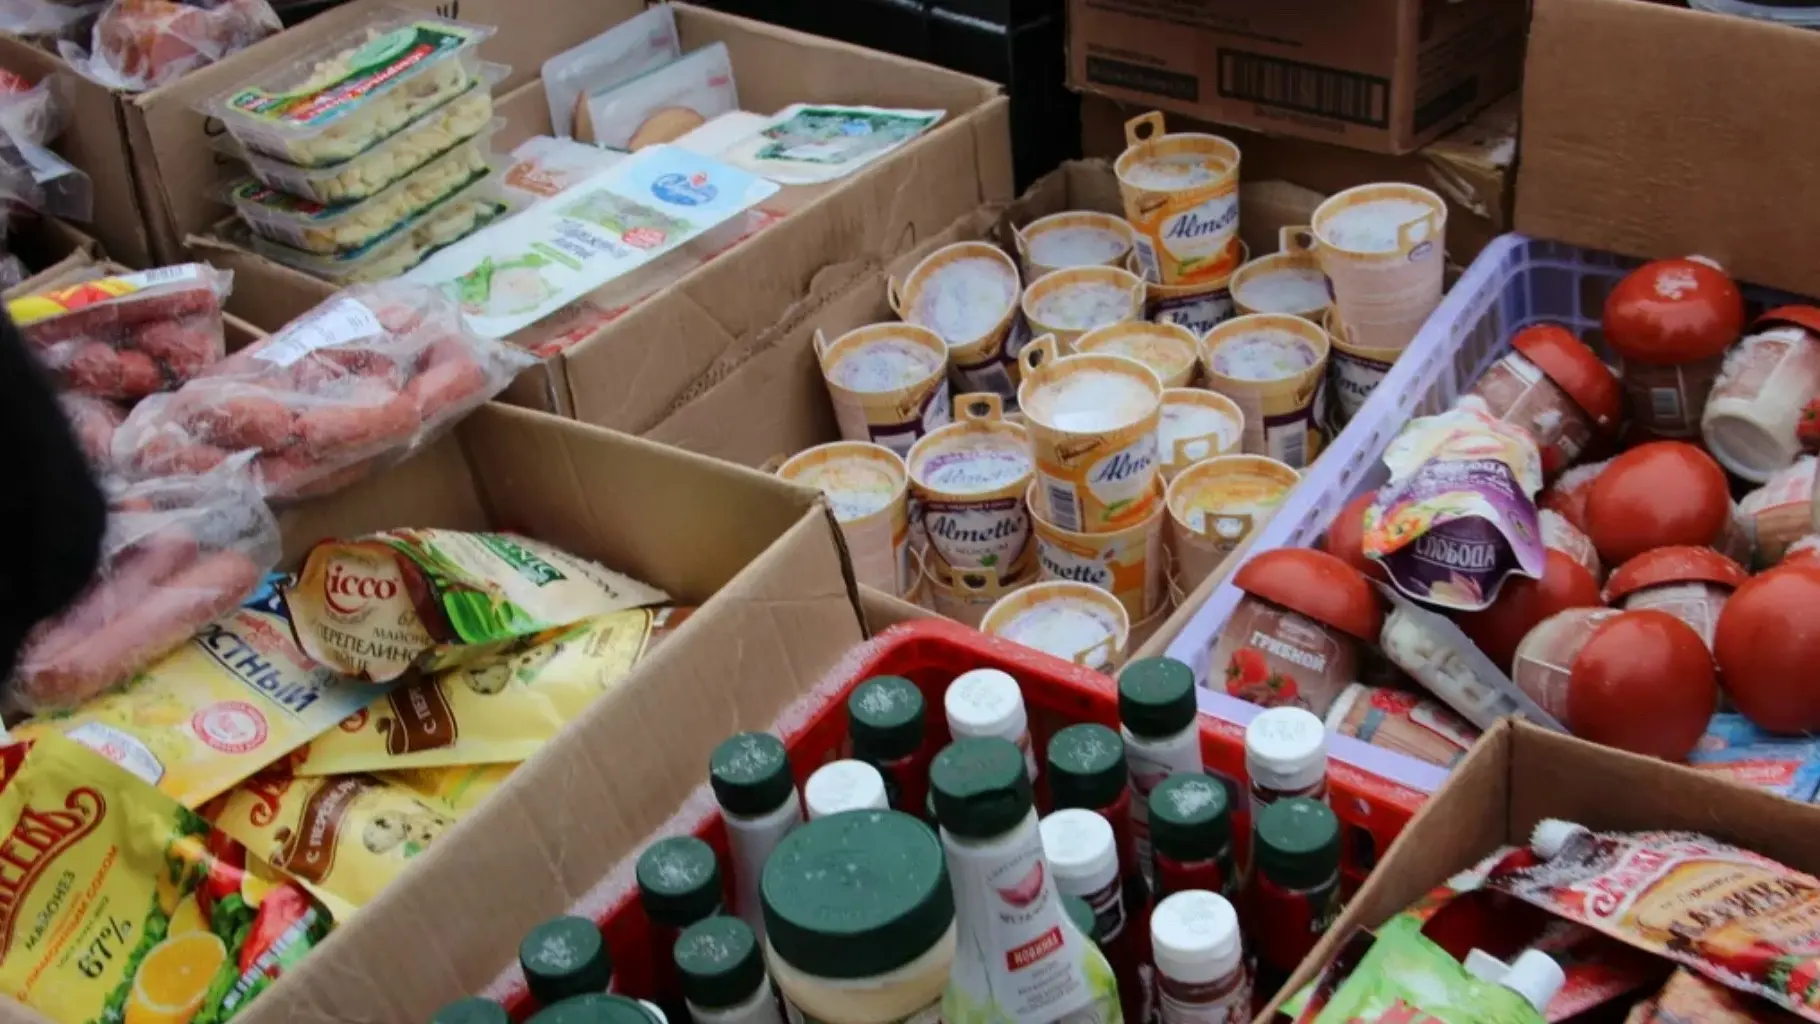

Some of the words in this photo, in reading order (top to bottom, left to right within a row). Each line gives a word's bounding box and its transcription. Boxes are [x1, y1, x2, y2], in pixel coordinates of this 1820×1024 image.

[934, 515, 1024, 543] Almette
[1415, 537, 1496, 568] СЛОБОДА
[1250, 630, 1327, 673] ГРИБНОЙ
[77, 914, 133, 980] 67%
